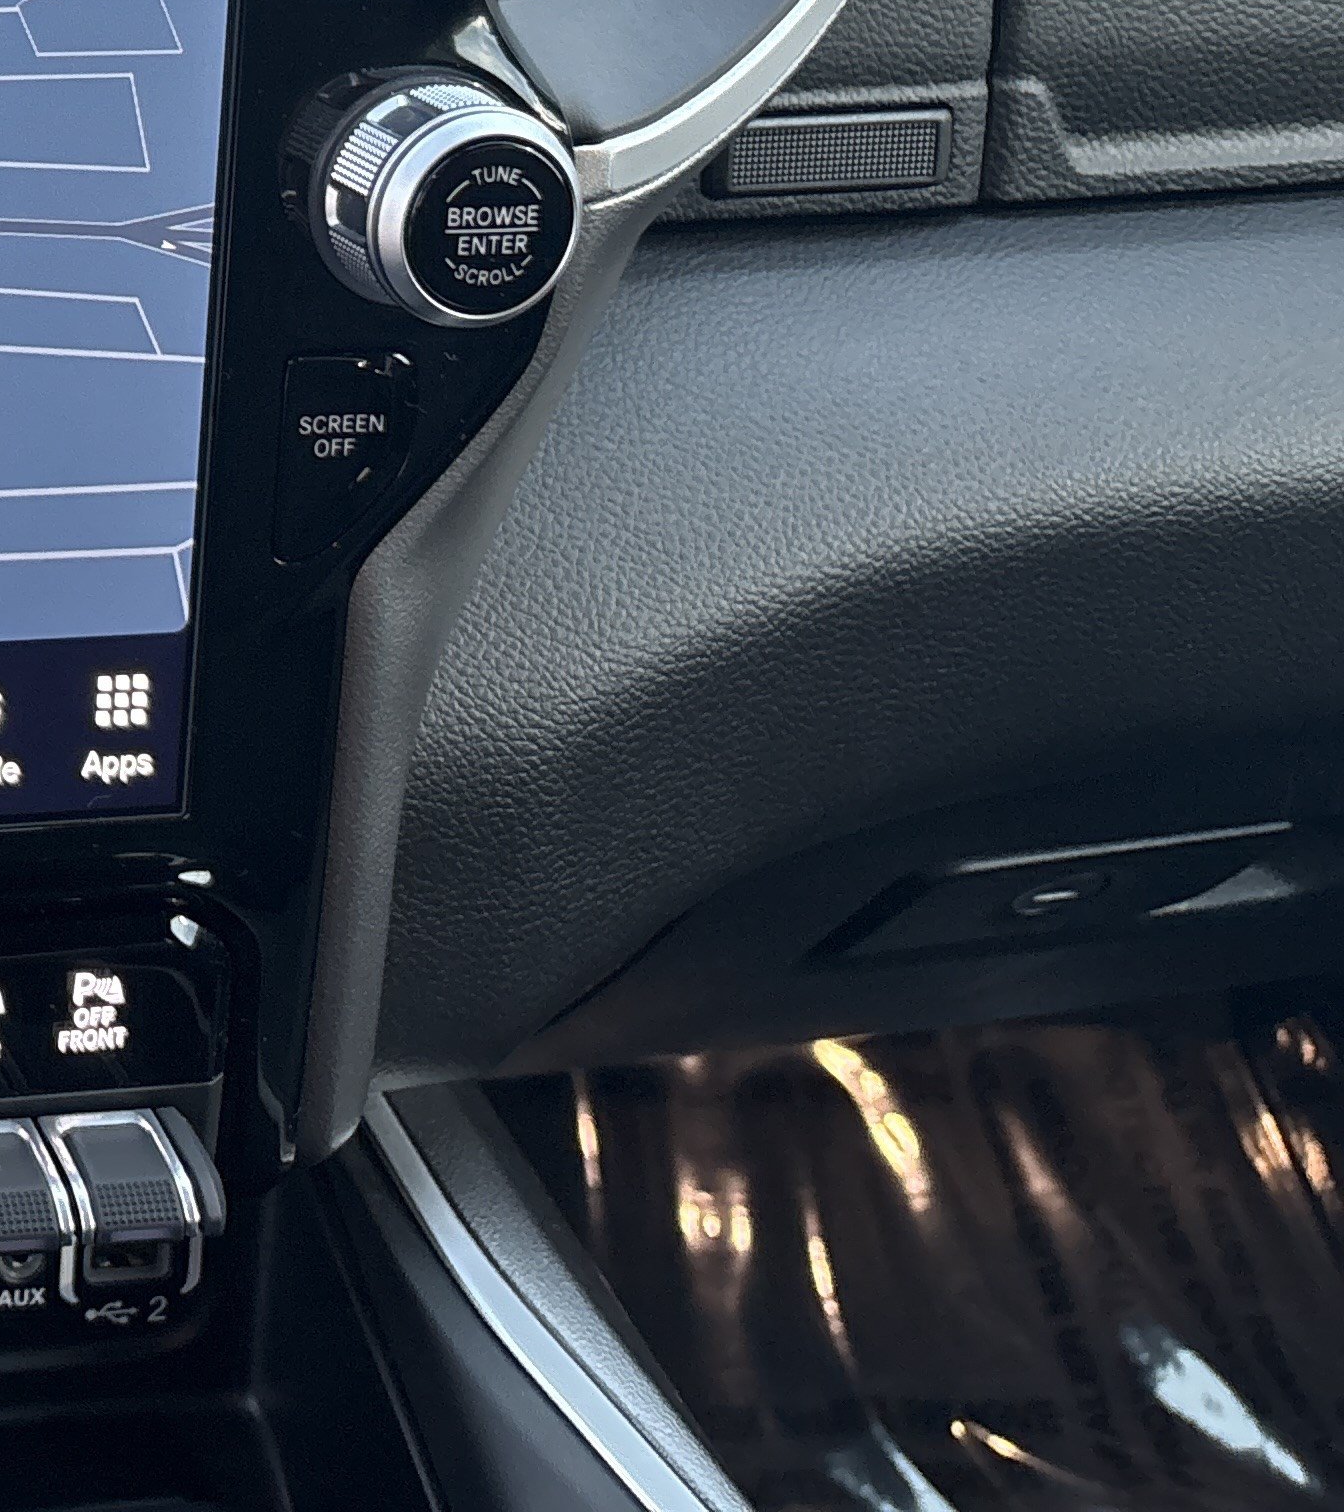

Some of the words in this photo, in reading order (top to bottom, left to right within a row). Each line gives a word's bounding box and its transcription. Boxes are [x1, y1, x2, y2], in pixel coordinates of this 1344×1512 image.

[471, 166, 524, 187] TUNE
[447, 205, 539, 227] BROWSE
[457, 234, 528, 257] ENTER
[454, 263, 525, 287] SCROLL
[298, 414, 385, 435] SCREEN
[314, 439, 356, 458] OFF
[81, 750, 155, 784] Apps
[73, 1005, 118, 1028] OFF
[58, 1026, 129, 1054] FRONT
[149, 1298, 168, 1322] 2
